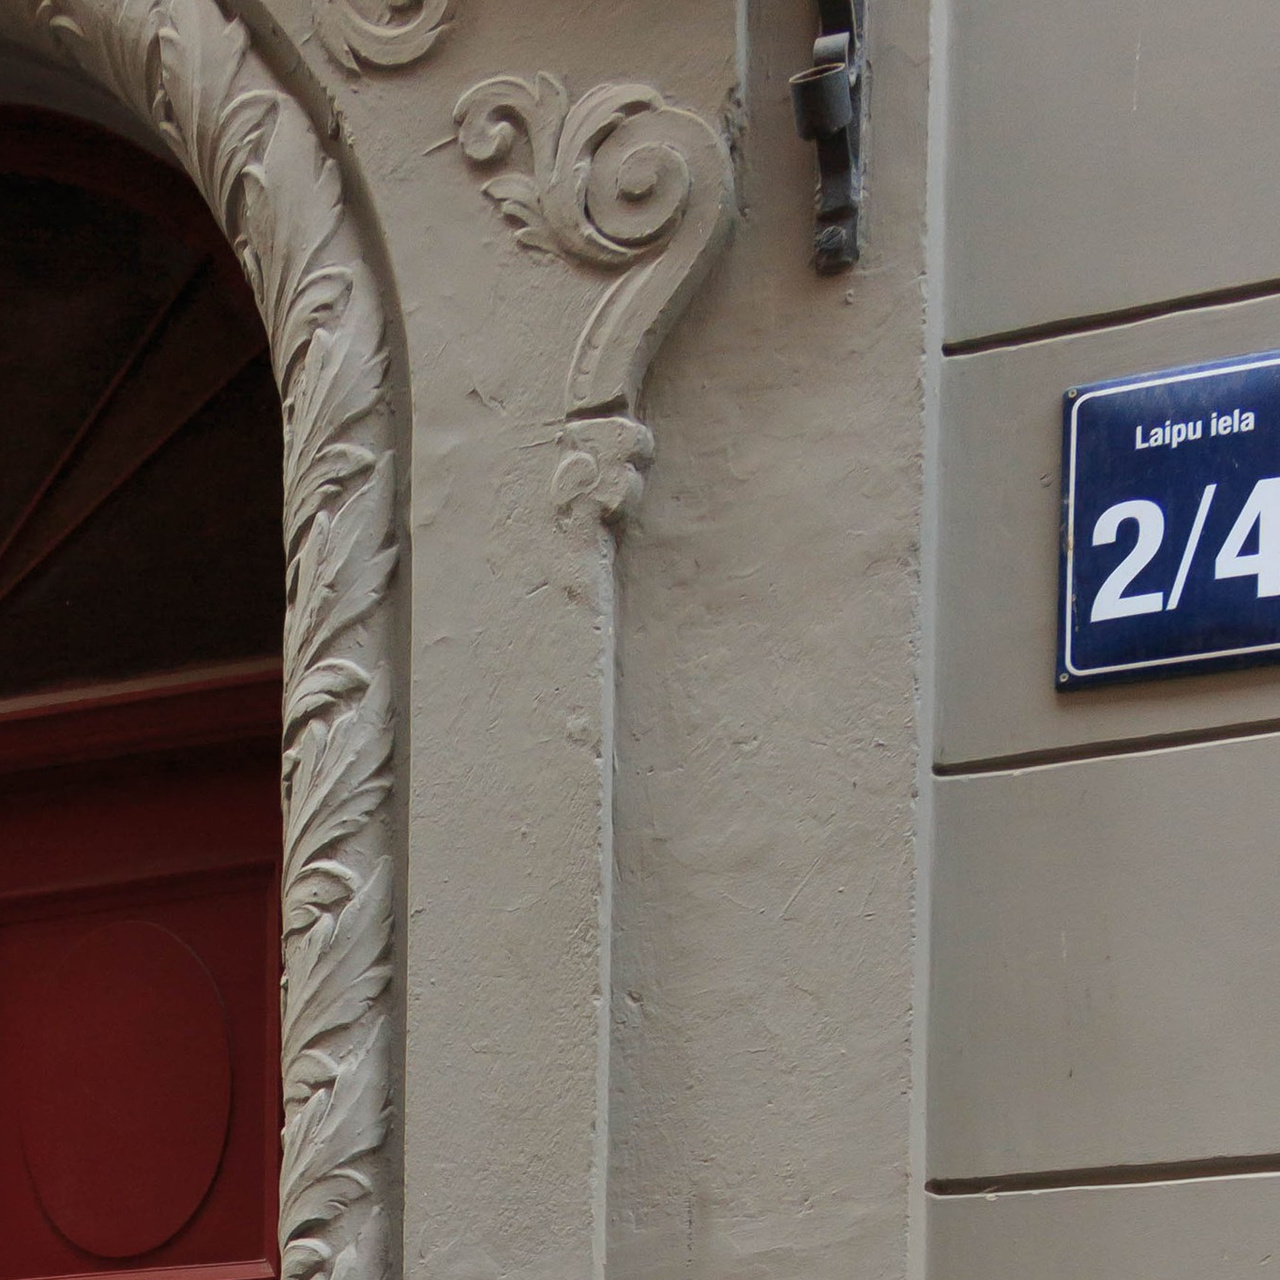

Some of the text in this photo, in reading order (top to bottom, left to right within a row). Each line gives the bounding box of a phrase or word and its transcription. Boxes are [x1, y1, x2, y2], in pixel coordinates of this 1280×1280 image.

[1135, 408, 1255, 450] Laipu iela
[1090, 476, 1280, 623] 2/4
